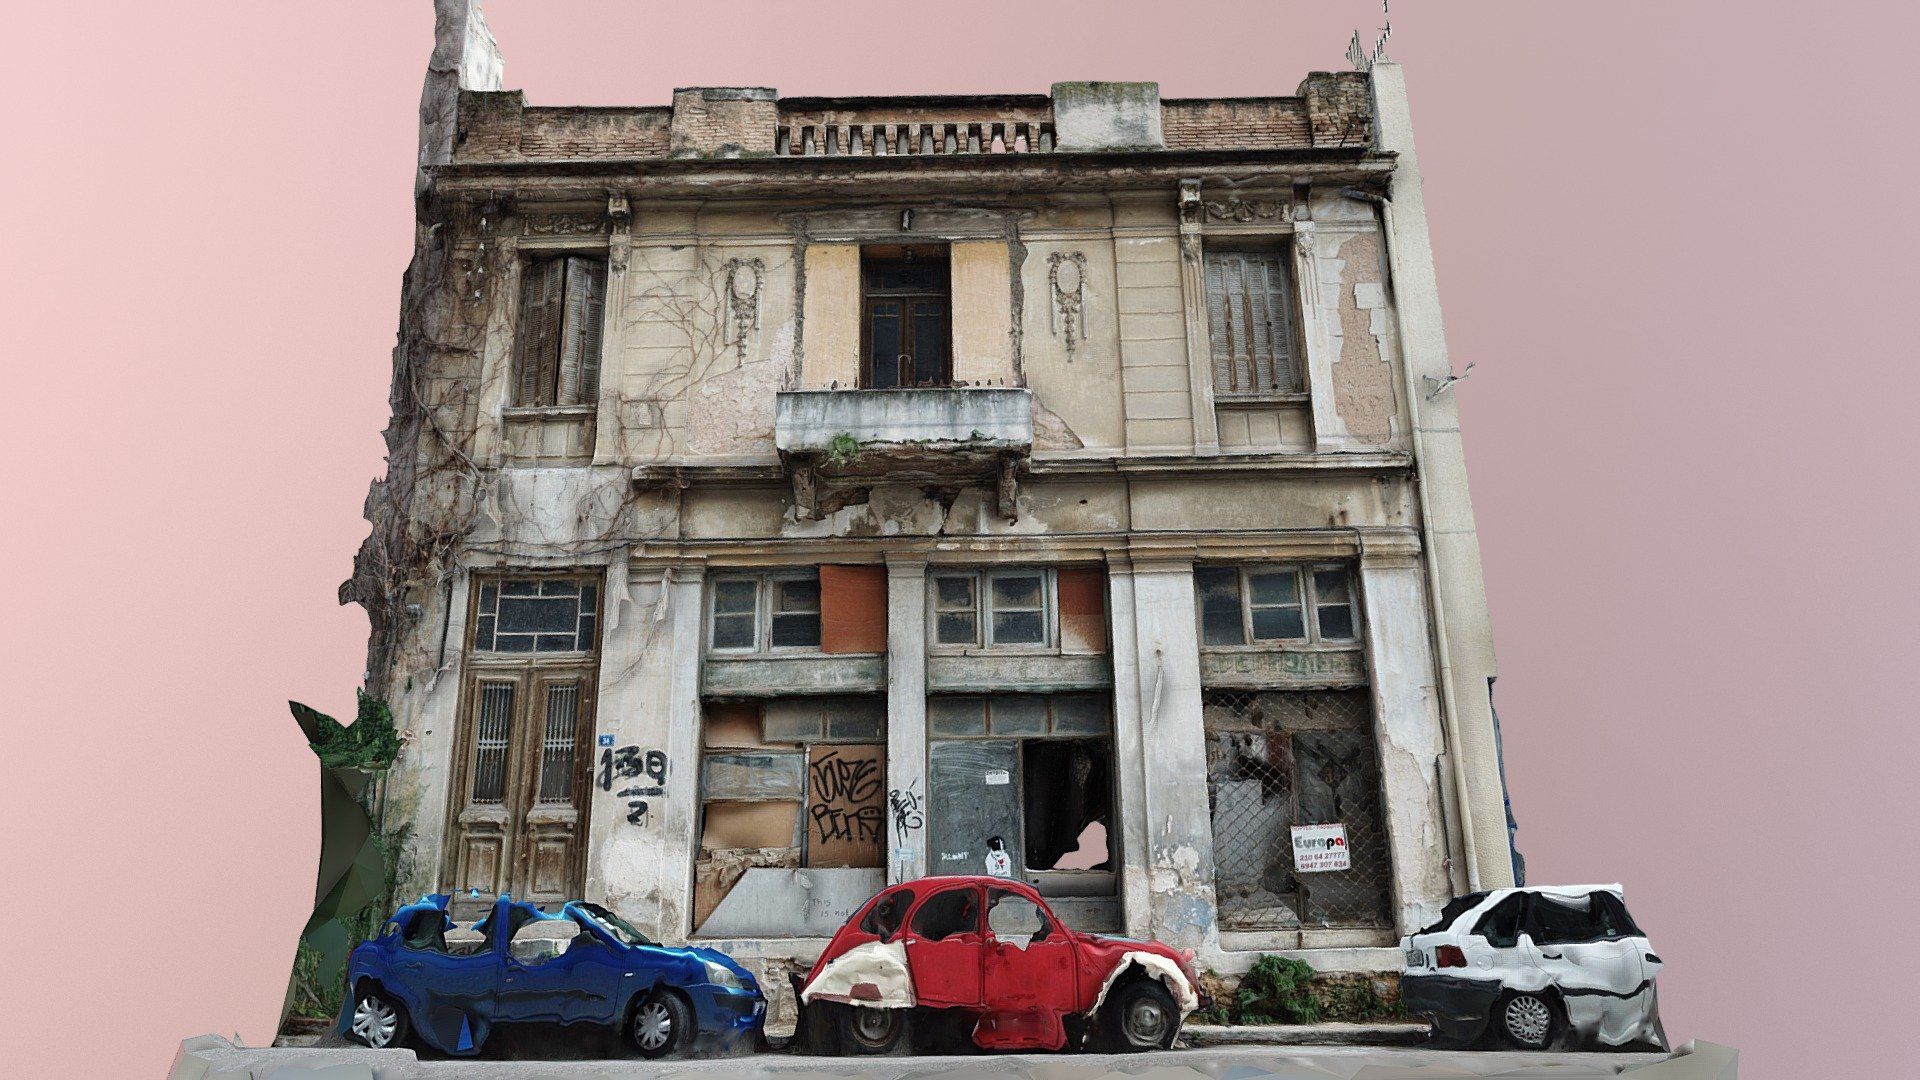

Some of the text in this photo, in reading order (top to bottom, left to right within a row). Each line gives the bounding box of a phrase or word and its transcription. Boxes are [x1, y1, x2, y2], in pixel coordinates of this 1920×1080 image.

[1294, 835, 1345, 850] Europa
[1300, 854, 1313, 862] 210
[1324, 852, 1346, 860] 27777
[1300, 862, 1318, 870] 6947
